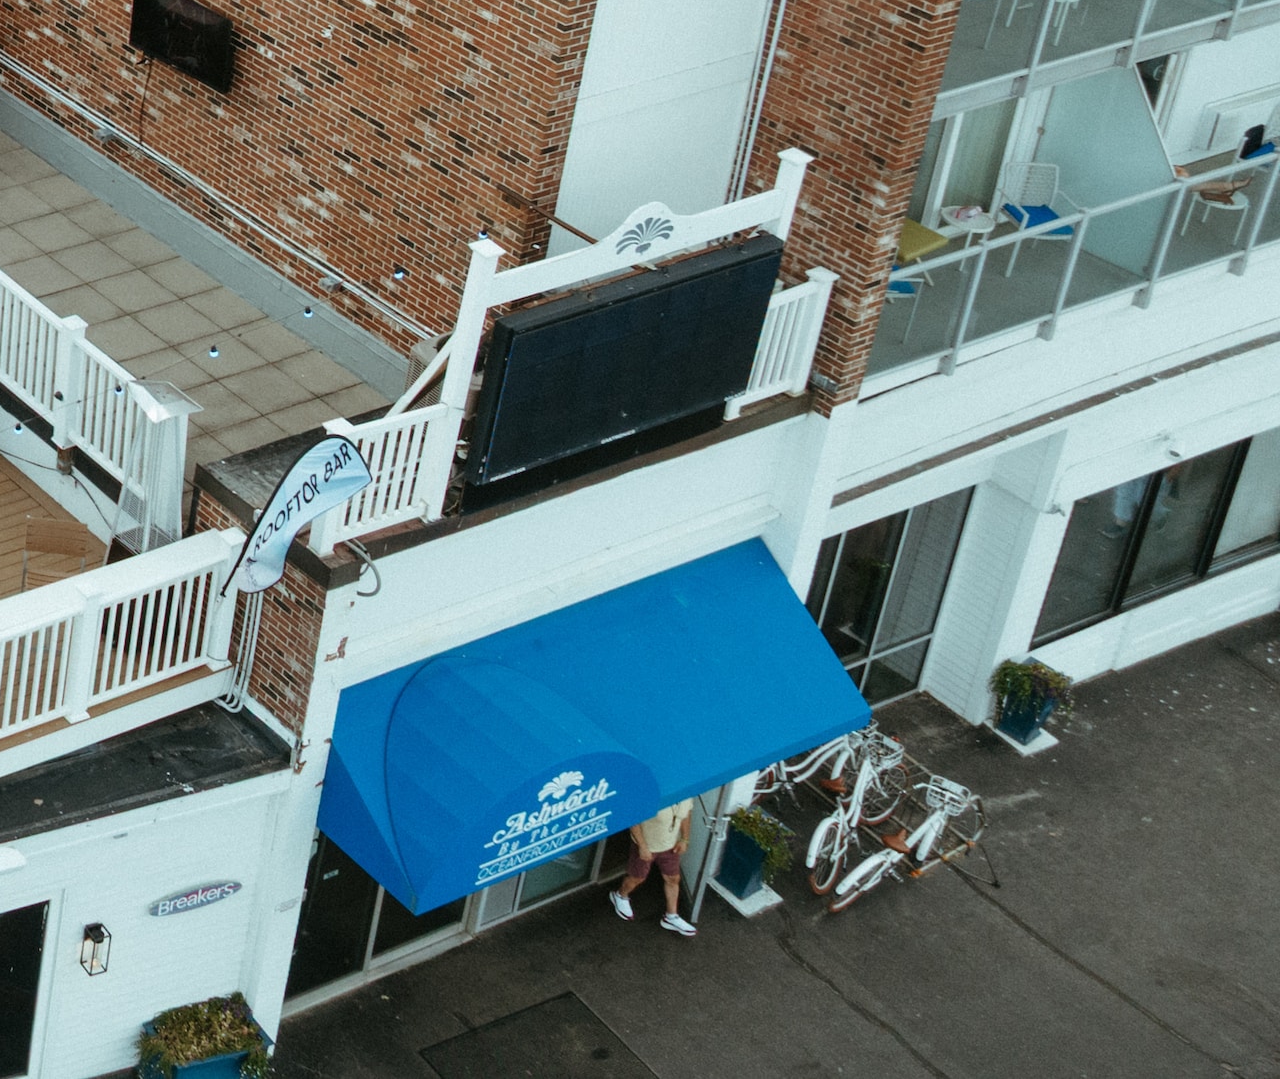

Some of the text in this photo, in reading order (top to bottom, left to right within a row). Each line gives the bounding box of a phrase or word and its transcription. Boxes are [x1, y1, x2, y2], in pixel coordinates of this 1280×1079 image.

[253, 442, 352, 556] ROOFTOP BAR
[492, 778, 609, 844] Ashworth
[498, 808, 597, 856] By The Sea
[477, 818, 608, 880] OCEANFRONT HOTEL
